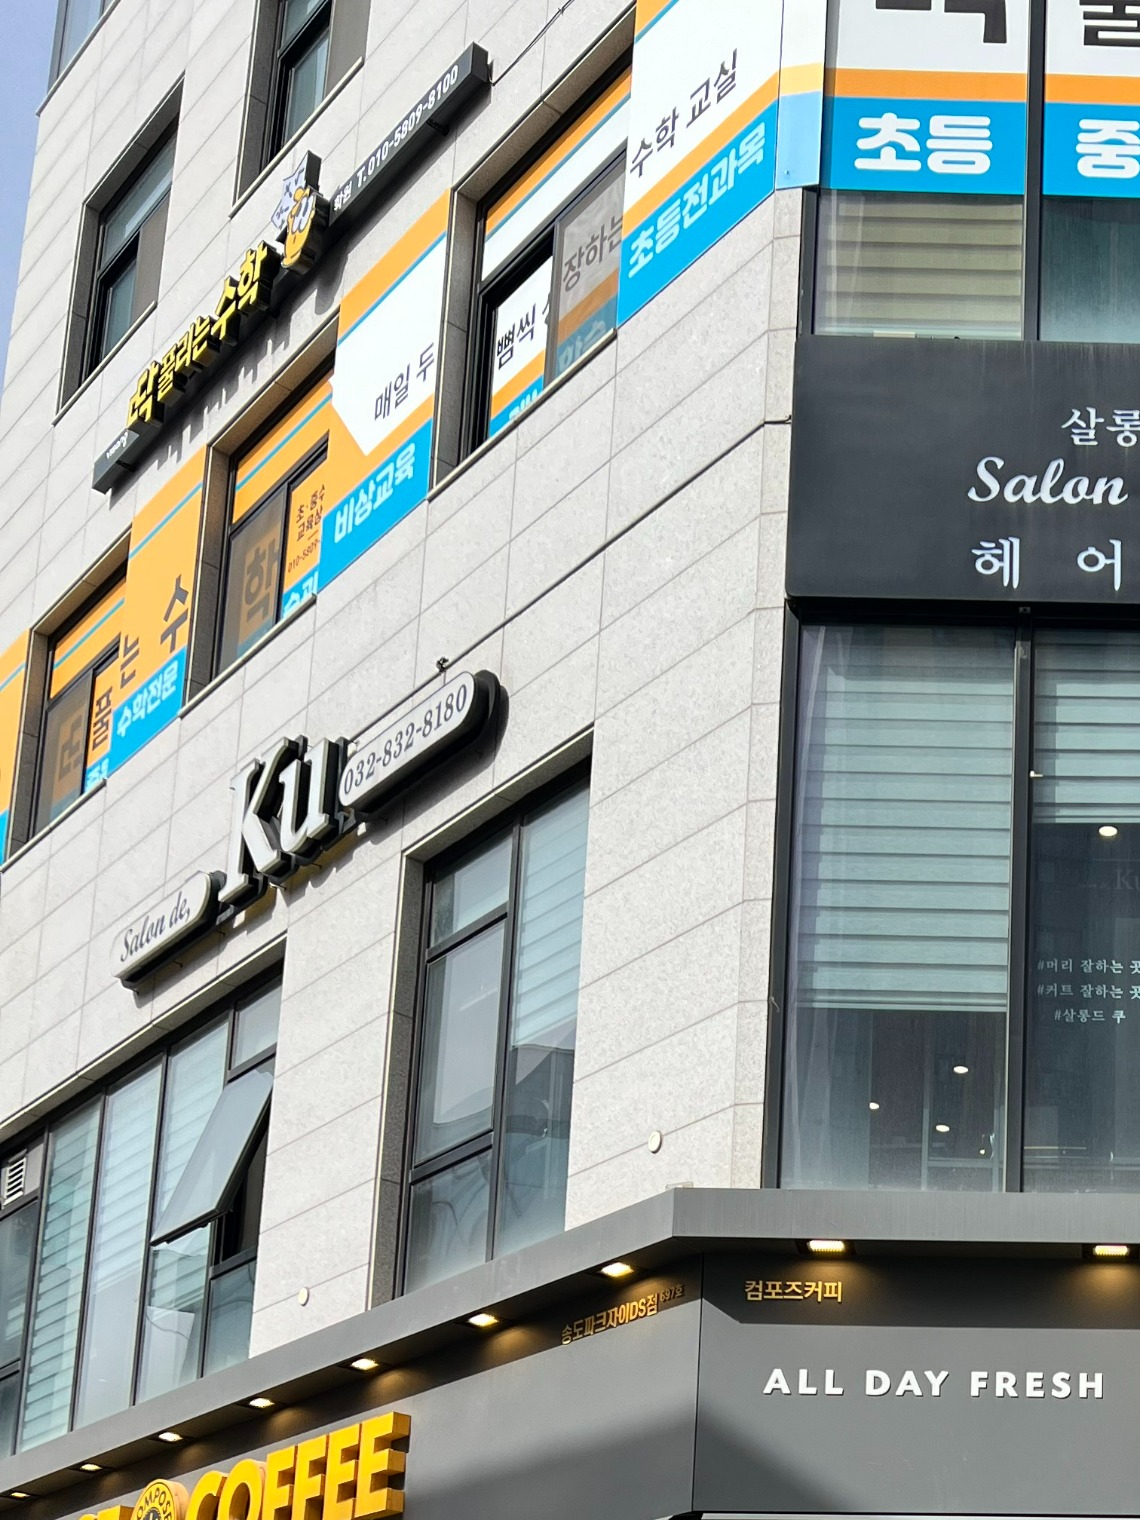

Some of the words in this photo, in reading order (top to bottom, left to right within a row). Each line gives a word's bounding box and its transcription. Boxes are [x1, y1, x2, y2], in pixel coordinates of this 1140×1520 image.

[630, 106, 679, 178] 수학
[686, 47, 738, 129] 교실
[854, 112, 993, 175] 초등
[628, 121, 765, 279] 초등전과목
[211, 240, 268, 341] 수학
[374, 364, 410, 421] 매일
[416, 342, 434, 382] 두
[333, 442, 416, 544] 비상교육
[967, 456, 1129, 507] Salon
[116, 660, 179, 737] 수학전문
[343, 683, 469, 797] 032-832-8180
[218, 736, 337, 903] Ku
[120, 910, 167, 963] Salon
[1037, 958, 1074, 974] #머리
[1080, 958, 1124, 975] 잘하는
[1080, 983, 1124, 1000] 잘하는
[1112, 1008, 1126, 1024] 쿠
[561, 1293, 659, 1346] 송도파크자이DS점
[744, 1279, 843, 1303] 컴포즈커피
[762, 1368, 845, 1396] ALL
[865, 1370, 950, 1398] DAY
[970, 1371, 1105, 1399] FRESH
